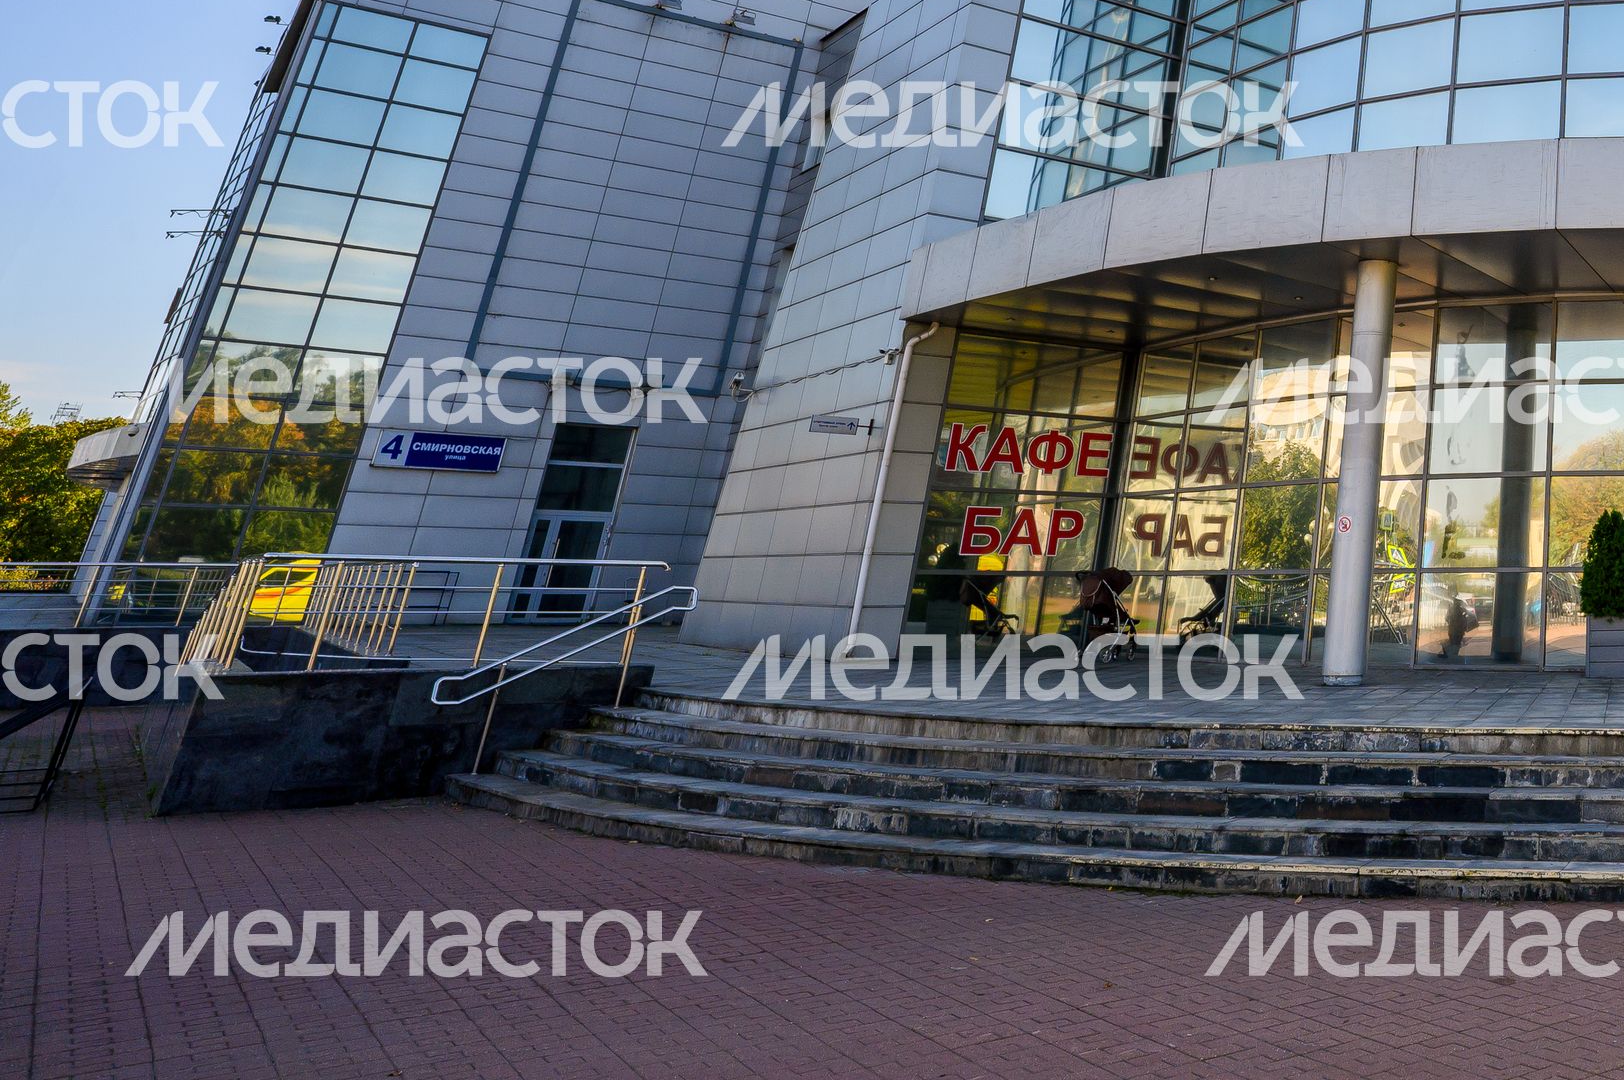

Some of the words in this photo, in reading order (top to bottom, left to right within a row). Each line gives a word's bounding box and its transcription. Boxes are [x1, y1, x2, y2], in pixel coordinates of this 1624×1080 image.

[380, 434, 405, 460] 4
[412, 442, 501, 456] СМИРНОВСКАЯ
[945, 422, 1114, 478] КАФЕ
[959, 505, 1085, 556] БАР
